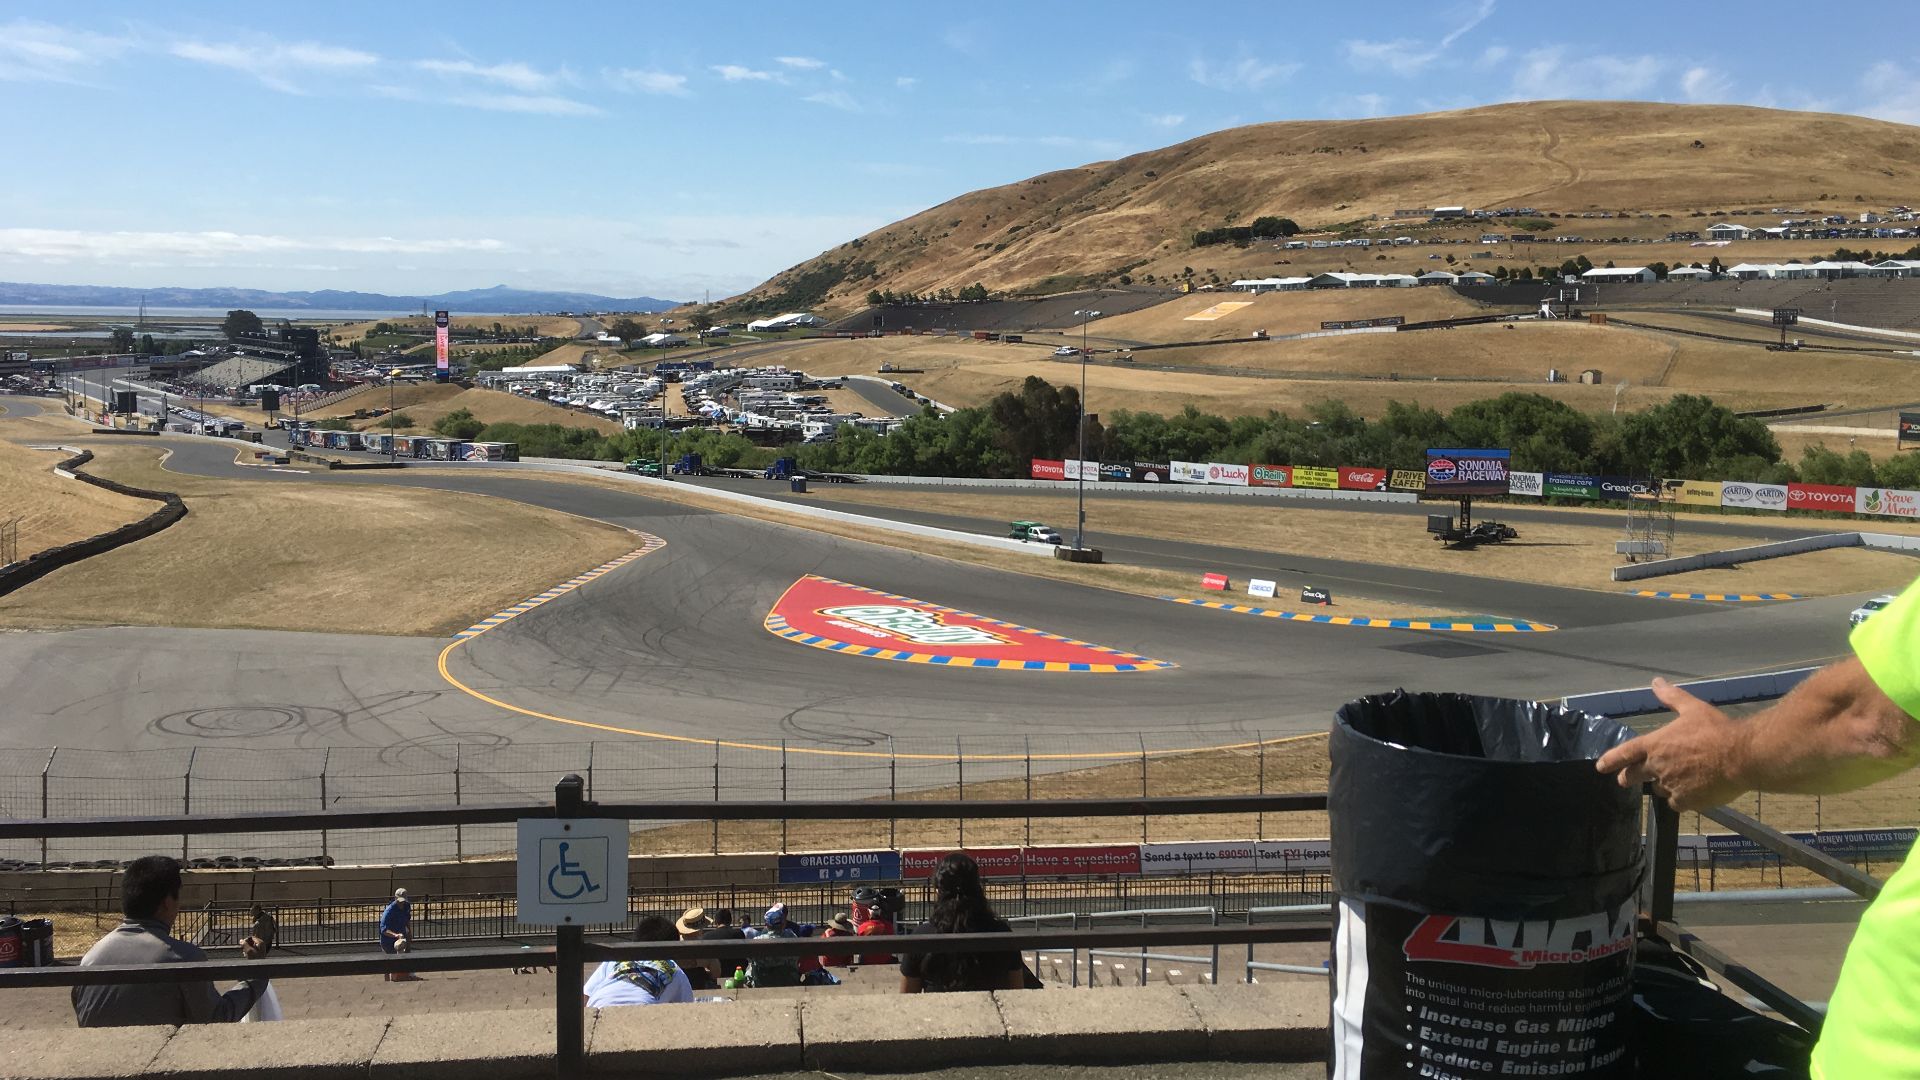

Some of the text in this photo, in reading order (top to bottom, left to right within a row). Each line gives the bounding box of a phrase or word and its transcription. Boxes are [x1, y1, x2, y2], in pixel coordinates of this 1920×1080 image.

[1042, 466, 1063, 474] TOYOTA
[1076, 465, 1098, 474] TYOTA
[1099, 463, 1132, 473] GoPro
[1458, 460, 1503, 471] SONOMA
[1221, 467, 1248, 482] Lucky
[1254, 466, 1287, 481] O'Reilly
[1397, 471, 1423, 479] DRIVE
[1458, 471, 1507, 481] RACEWAY
[1510, 474, 1536, 482] ONOMA
[1392, 480, 1425, 488] SAFETY
[1509, 481, 1540, 489] ACEWAY
[1549, 477, 1575, 485] trauma
[1724, 487, 1752, 499] GARTON
[1757, 489, 1785, 501] GARTON
[1807, 492, 1855, 504] TOYOTA
[1884, 490, 1914, 503] Save
[1883, 502, 1918, 516] Mart
[1251, 584, 1272, 592] GEICO
[1818, 835, 1843, 844] RENEW
[1844, 835, 1865, 843] YOUR
[1865, 833, 1893, 841] TICKETS
[1709, 841, 1741, 849] DOWNLOAD
[800, 853, 880, 867] @RACESONOMA
[905, 856, 938, 868] Need
[1027, 853, 1059, 867] Have
[1062, 855, 1070, 865] a
[1074, 852, 1138, 868] question?
[1144, 853, 1172, 862] Send
[1183, 852, 1204, 861] text
[1206, 852, 1217, 861] to
[1259, 849, 1281, 860] Text
[1405, 971, 1425, 985] The
[1428, 980, 1467, 994] unique
[1470, 987, 1565, 999] micro-lubricating
[1405, 986, 1426, 999] into
[1428, 994, 1460, 1006] metal
[1463, 1000, 1485, 1011] and
[1488, 1003, 1526, 1013] reduce
[1529, 1002, 1572, 1012] harmful
[1419, 1006, 1616, 1034] Increase Gas Mileage
[1419, 1026, 1596, 1057] Extend Engine Life
[1419, 1045, 1494, 1072] Reduce
[1501, 1059, 1586, 1076] Emission
